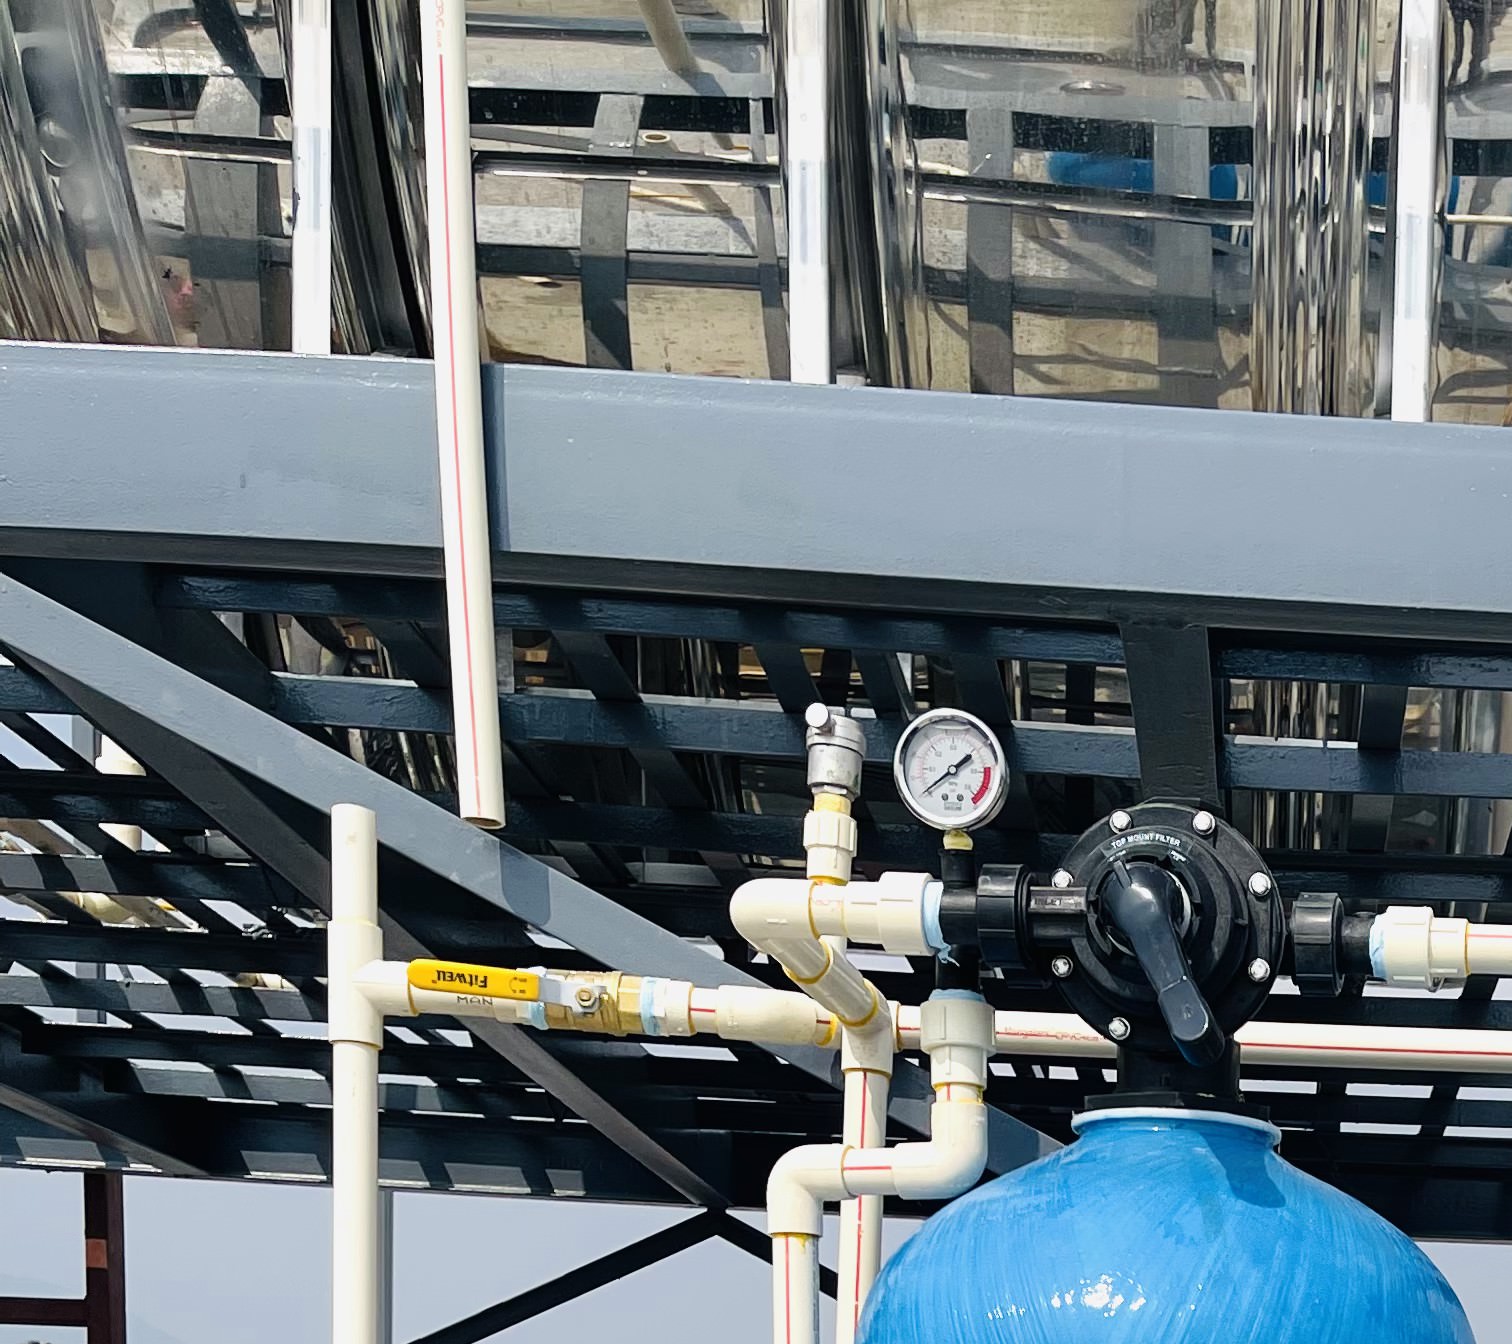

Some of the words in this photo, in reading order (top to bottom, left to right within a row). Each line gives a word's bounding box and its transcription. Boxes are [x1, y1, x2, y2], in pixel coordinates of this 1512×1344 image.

[1110, 837, 1126, 849] TOP
[1127, 832, 1153, 842] MOUNT
[1155, 833, 1181, 846] FILTER
